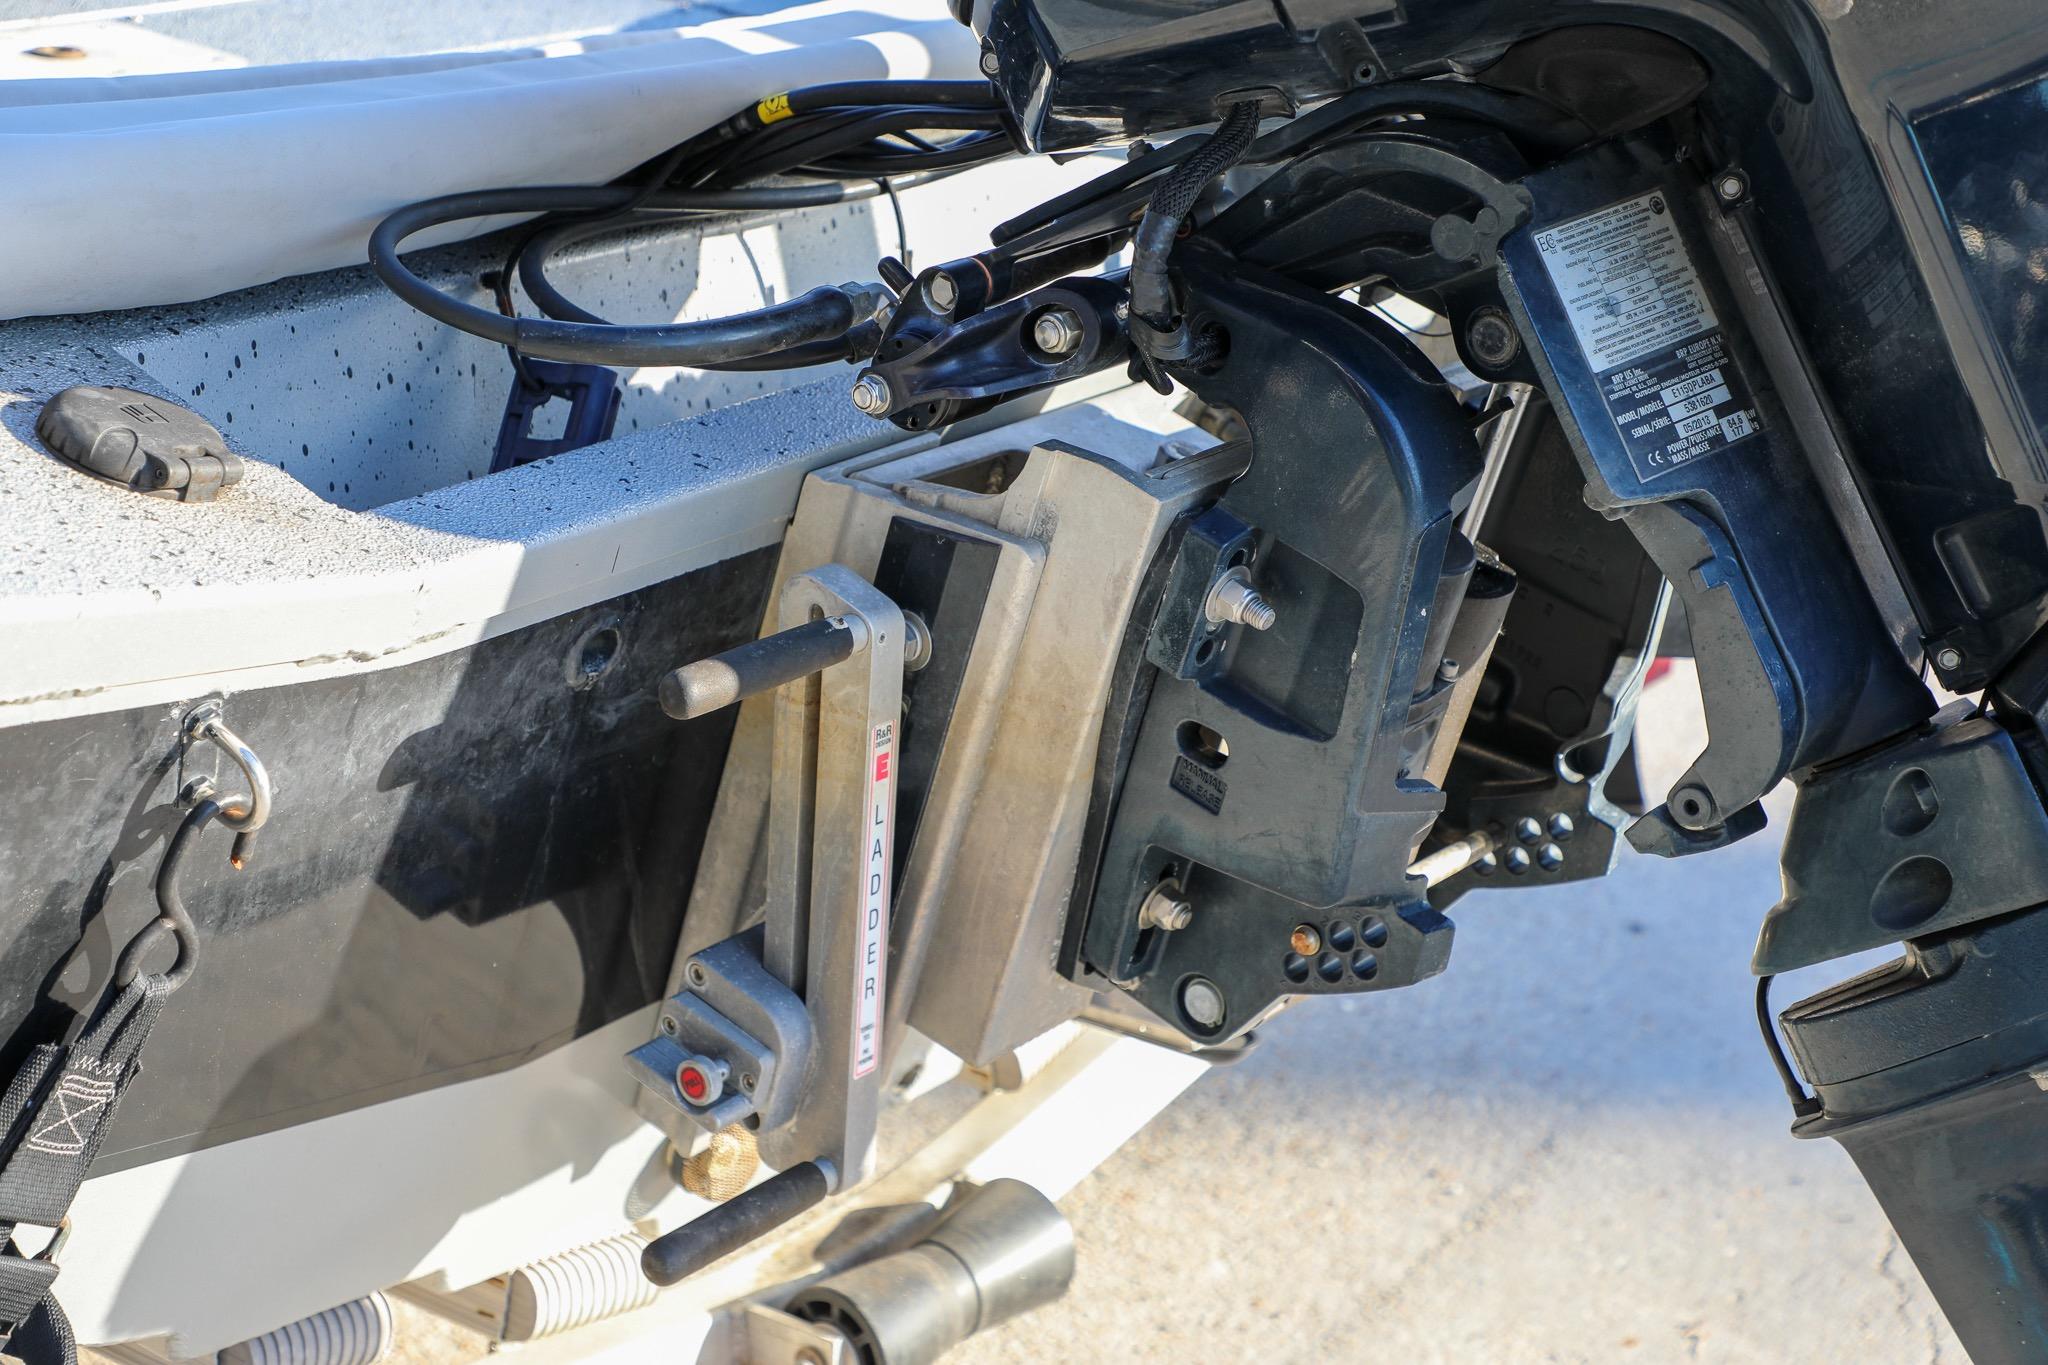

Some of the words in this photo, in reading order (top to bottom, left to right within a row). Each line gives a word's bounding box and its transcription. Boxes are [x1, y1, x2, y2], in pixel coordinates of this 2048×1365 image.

[1676, 347, 1687, 358] BRP
[1687, 340, 1711, 355] EUROPE
[1711, 334, 1723, 347] N.V.
[1612, 374, 1624, 384] BRP
[1633, 368, 1644, 377] Inc.
[1635, 387, 1660, 399] OUTBOARD
[1660, 369, 1700, 391] ENGINE/MOTEUR
[1672, 374, 1715, 399] E115DPLABA
[1685, 394, 1713, 413] 5381620
[1684, 416, 1711, 433] 05/2013
[1732, 426, 1745, 437] 177
[1667, 426, 1722, 454] POWER/PUISSANCE
[1672, 441, 1711, 463] MASS/MASSE
[877, 725, 892, 740] R&R
[1183, 758, 1224, 794] MANUAL
[1176, 774, 1222, 809] RELEASE
[864, 805, 884, 1000] LADDER
